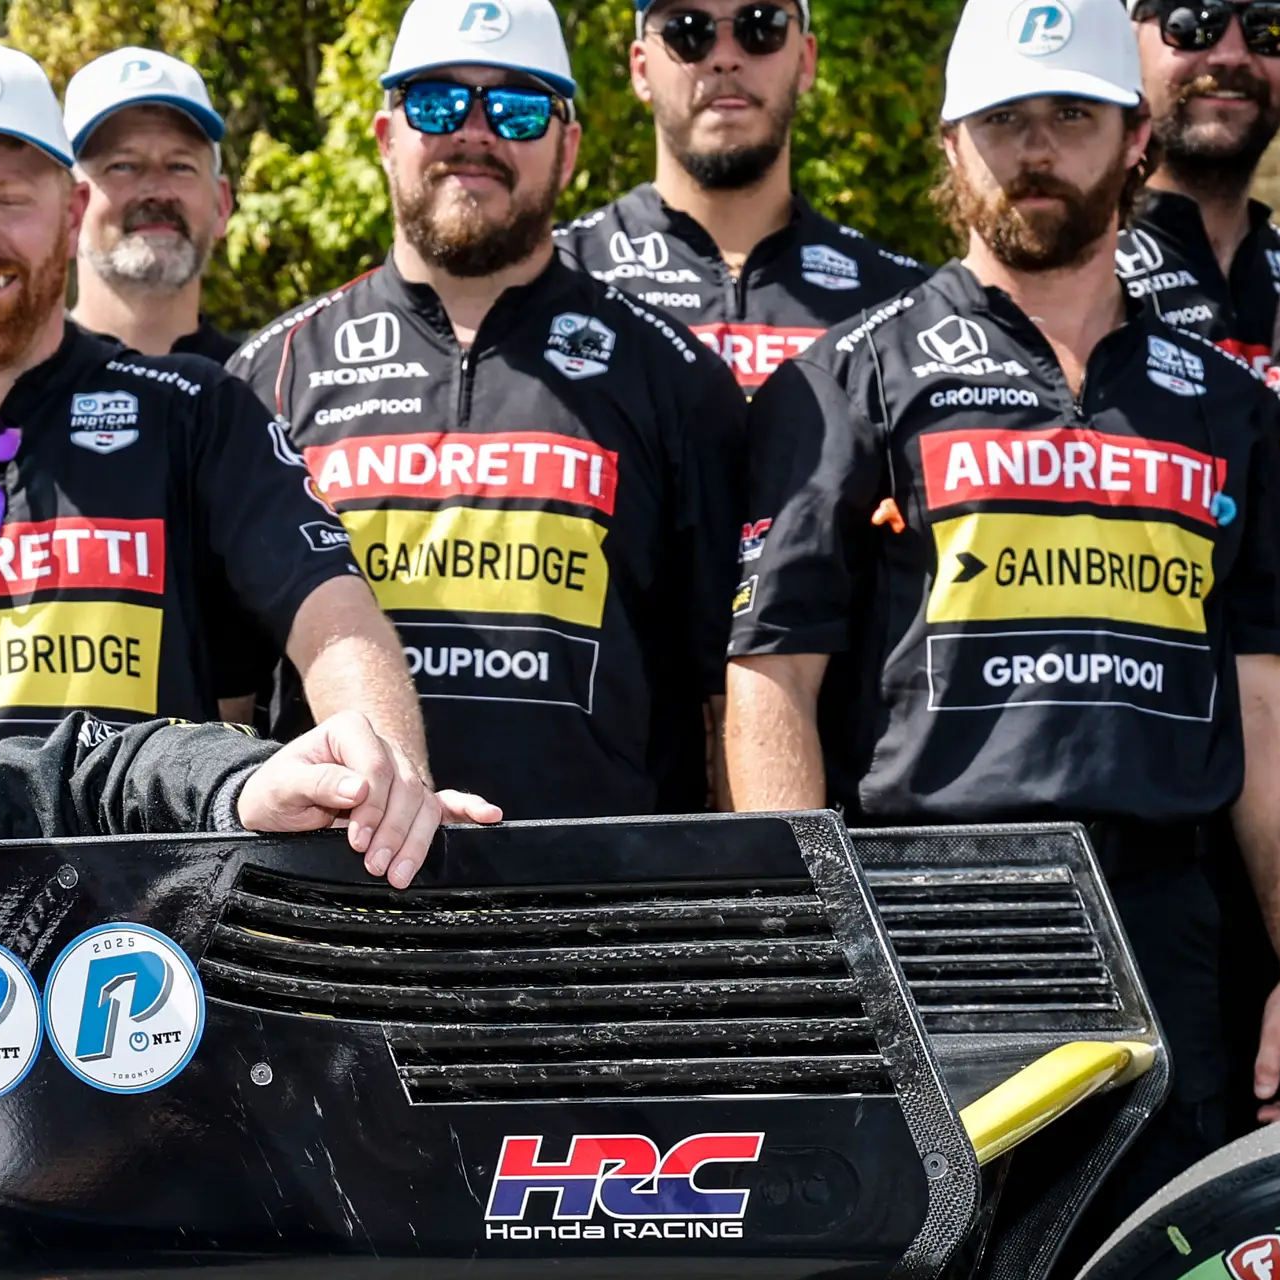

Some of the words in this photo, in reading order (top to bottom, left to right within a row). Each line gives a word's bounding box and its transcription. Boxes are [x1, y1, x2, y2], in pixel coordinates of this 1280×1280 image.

[307, 362, 430, 388] HONDA
[70, 414, 138, 428] INDYCAR
[314, 397, 422, 426] GROUP1001
[319, 442, 604, 498] ANDRETTI
[943, 440, 1214, 508] ANDRETTI
[365, 541, 588, 592] GAINBRIDGE
[994, 546, 1204, 601] GAINBRIDGE
[982, 654, 1163, 693] GROUP1001
[93, 937, 136, 954] 2025
[151, 1030, 182, 1046] NTT
[112, 1066, 156, 1081] TORONTO
[485, 1132, 766, 1222] HRC
[485, 1222, 606, 1241] Honda
[611, 1222, 745, 1241] RACING
